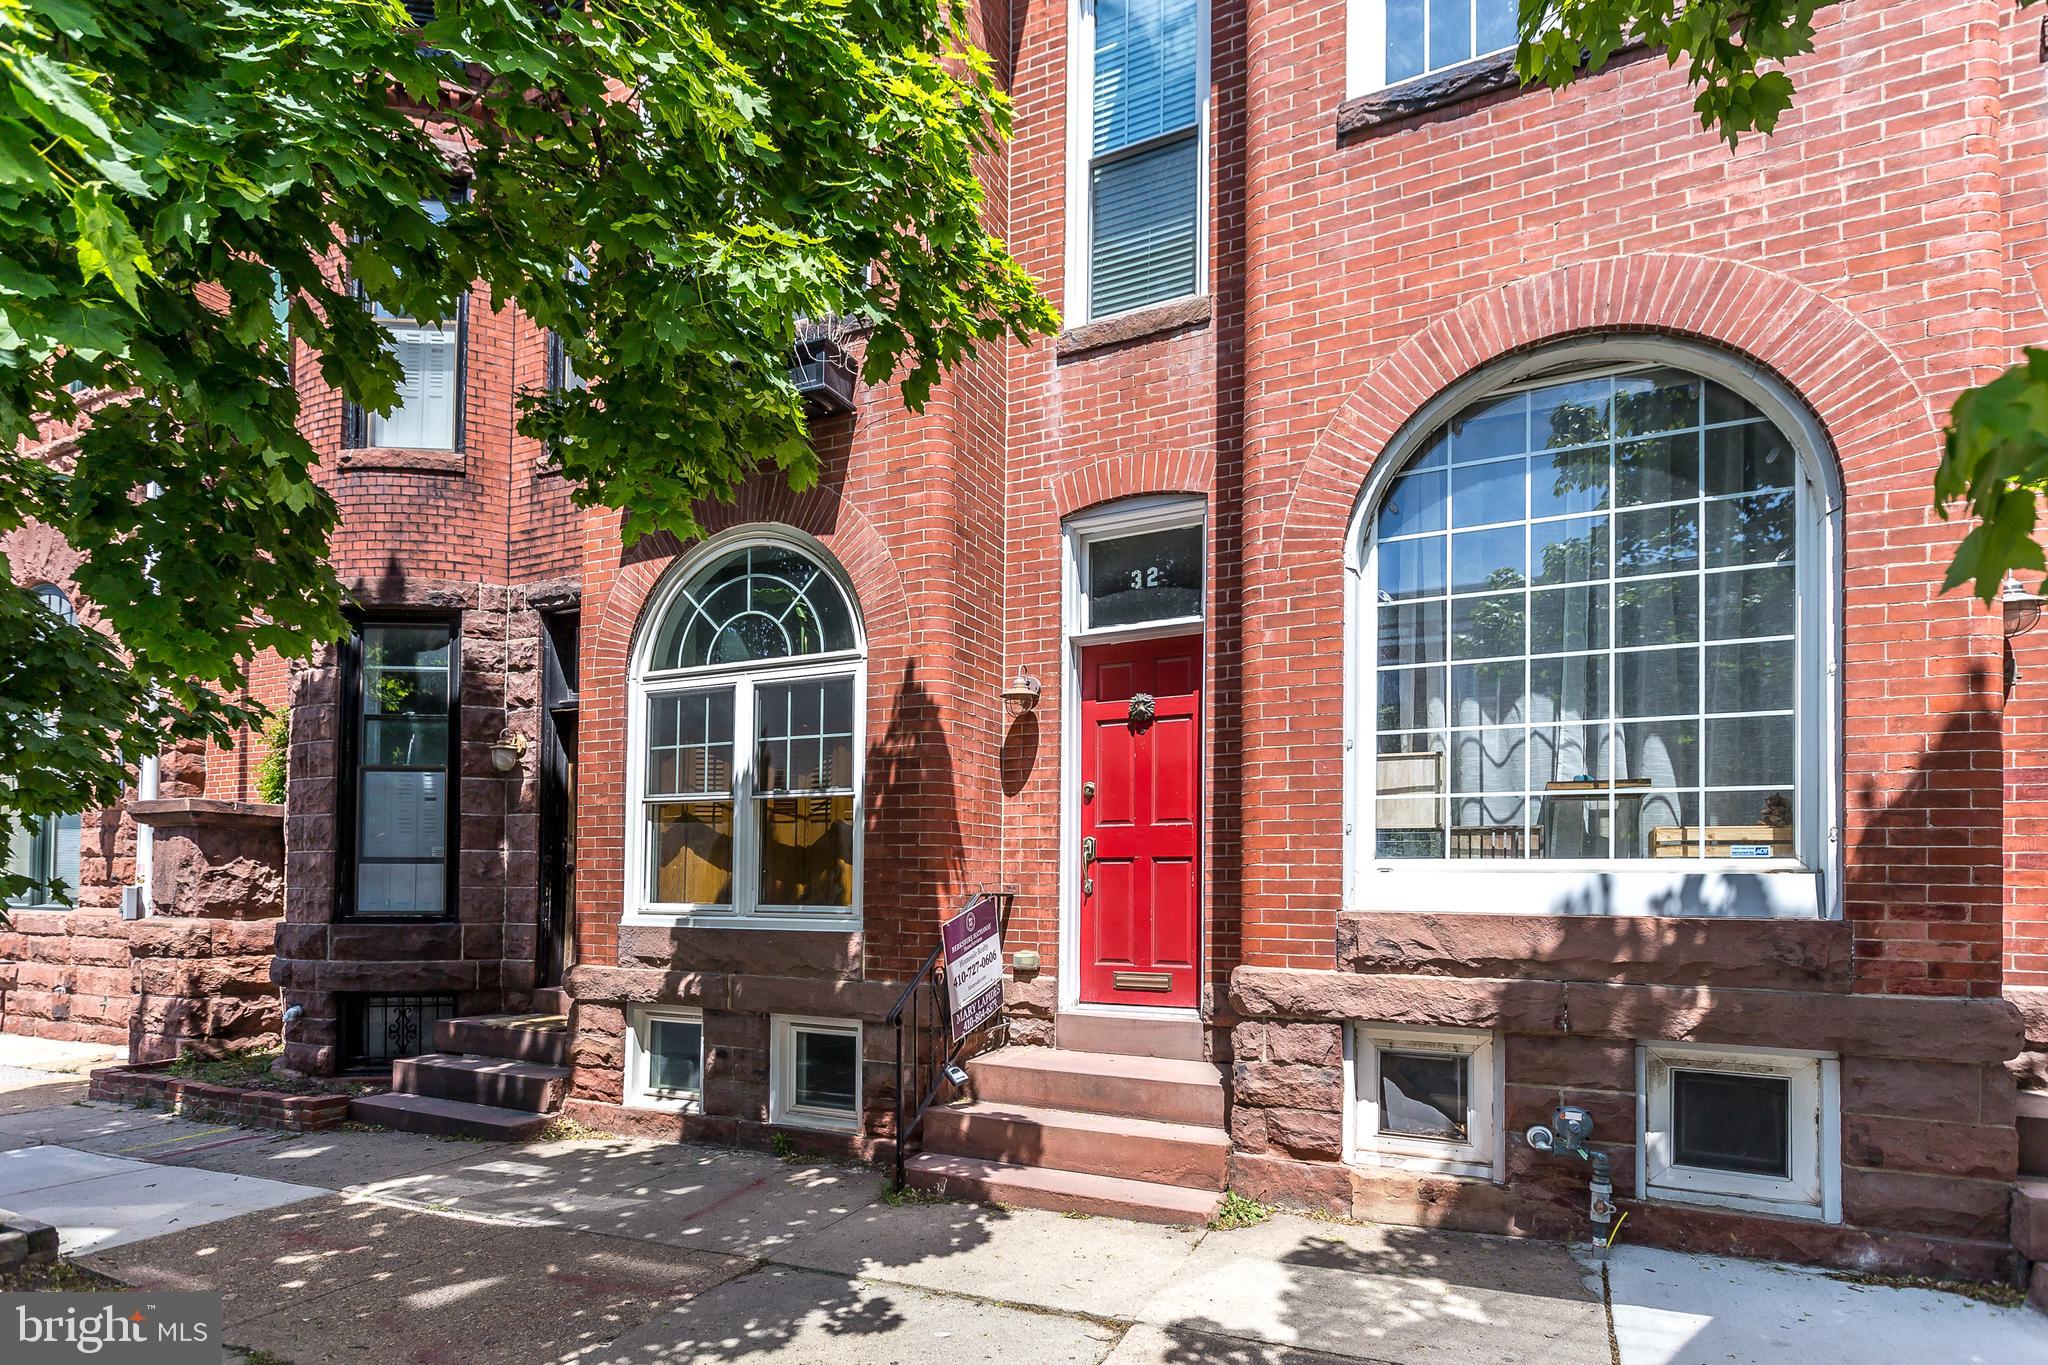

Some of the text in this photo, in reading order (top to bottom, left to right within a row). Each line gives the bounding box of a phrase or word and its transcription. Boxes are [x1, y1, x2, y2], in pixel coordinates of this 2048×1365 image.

[1131, 567, 1158, 589] 32
[952, 935, 974, 954] BERKSHIRE
[953, 949, 997, 988] 410-727-0606
[956, 1002, 977, 1025] MARY
